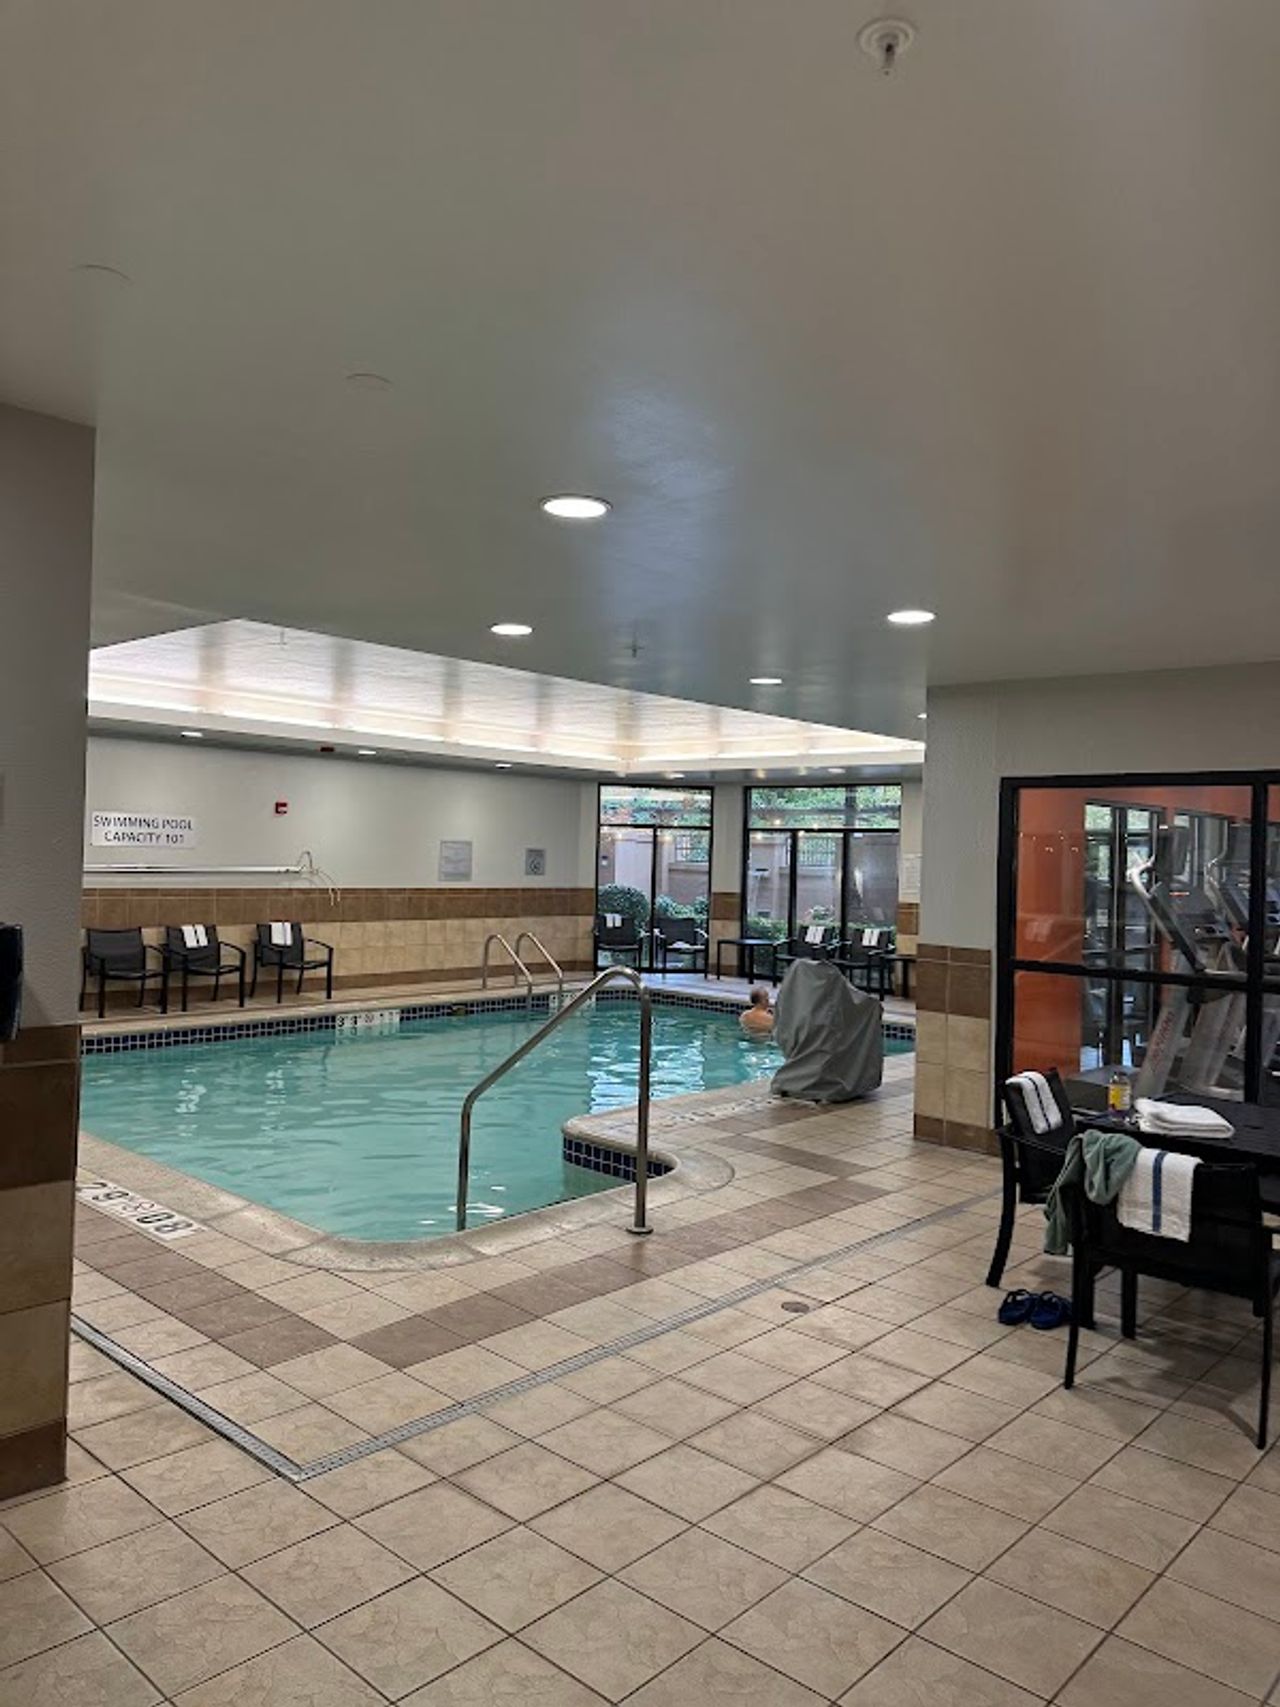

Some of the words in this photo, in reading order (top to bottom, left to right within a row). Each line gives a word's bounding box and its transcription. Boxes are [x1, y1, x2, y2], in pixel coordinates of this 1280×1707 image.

[93, 815, 159, 829] SWIMMING
[162, 819, 193, 830] POOL
[104, 832, 161, 843] CAPACITY
